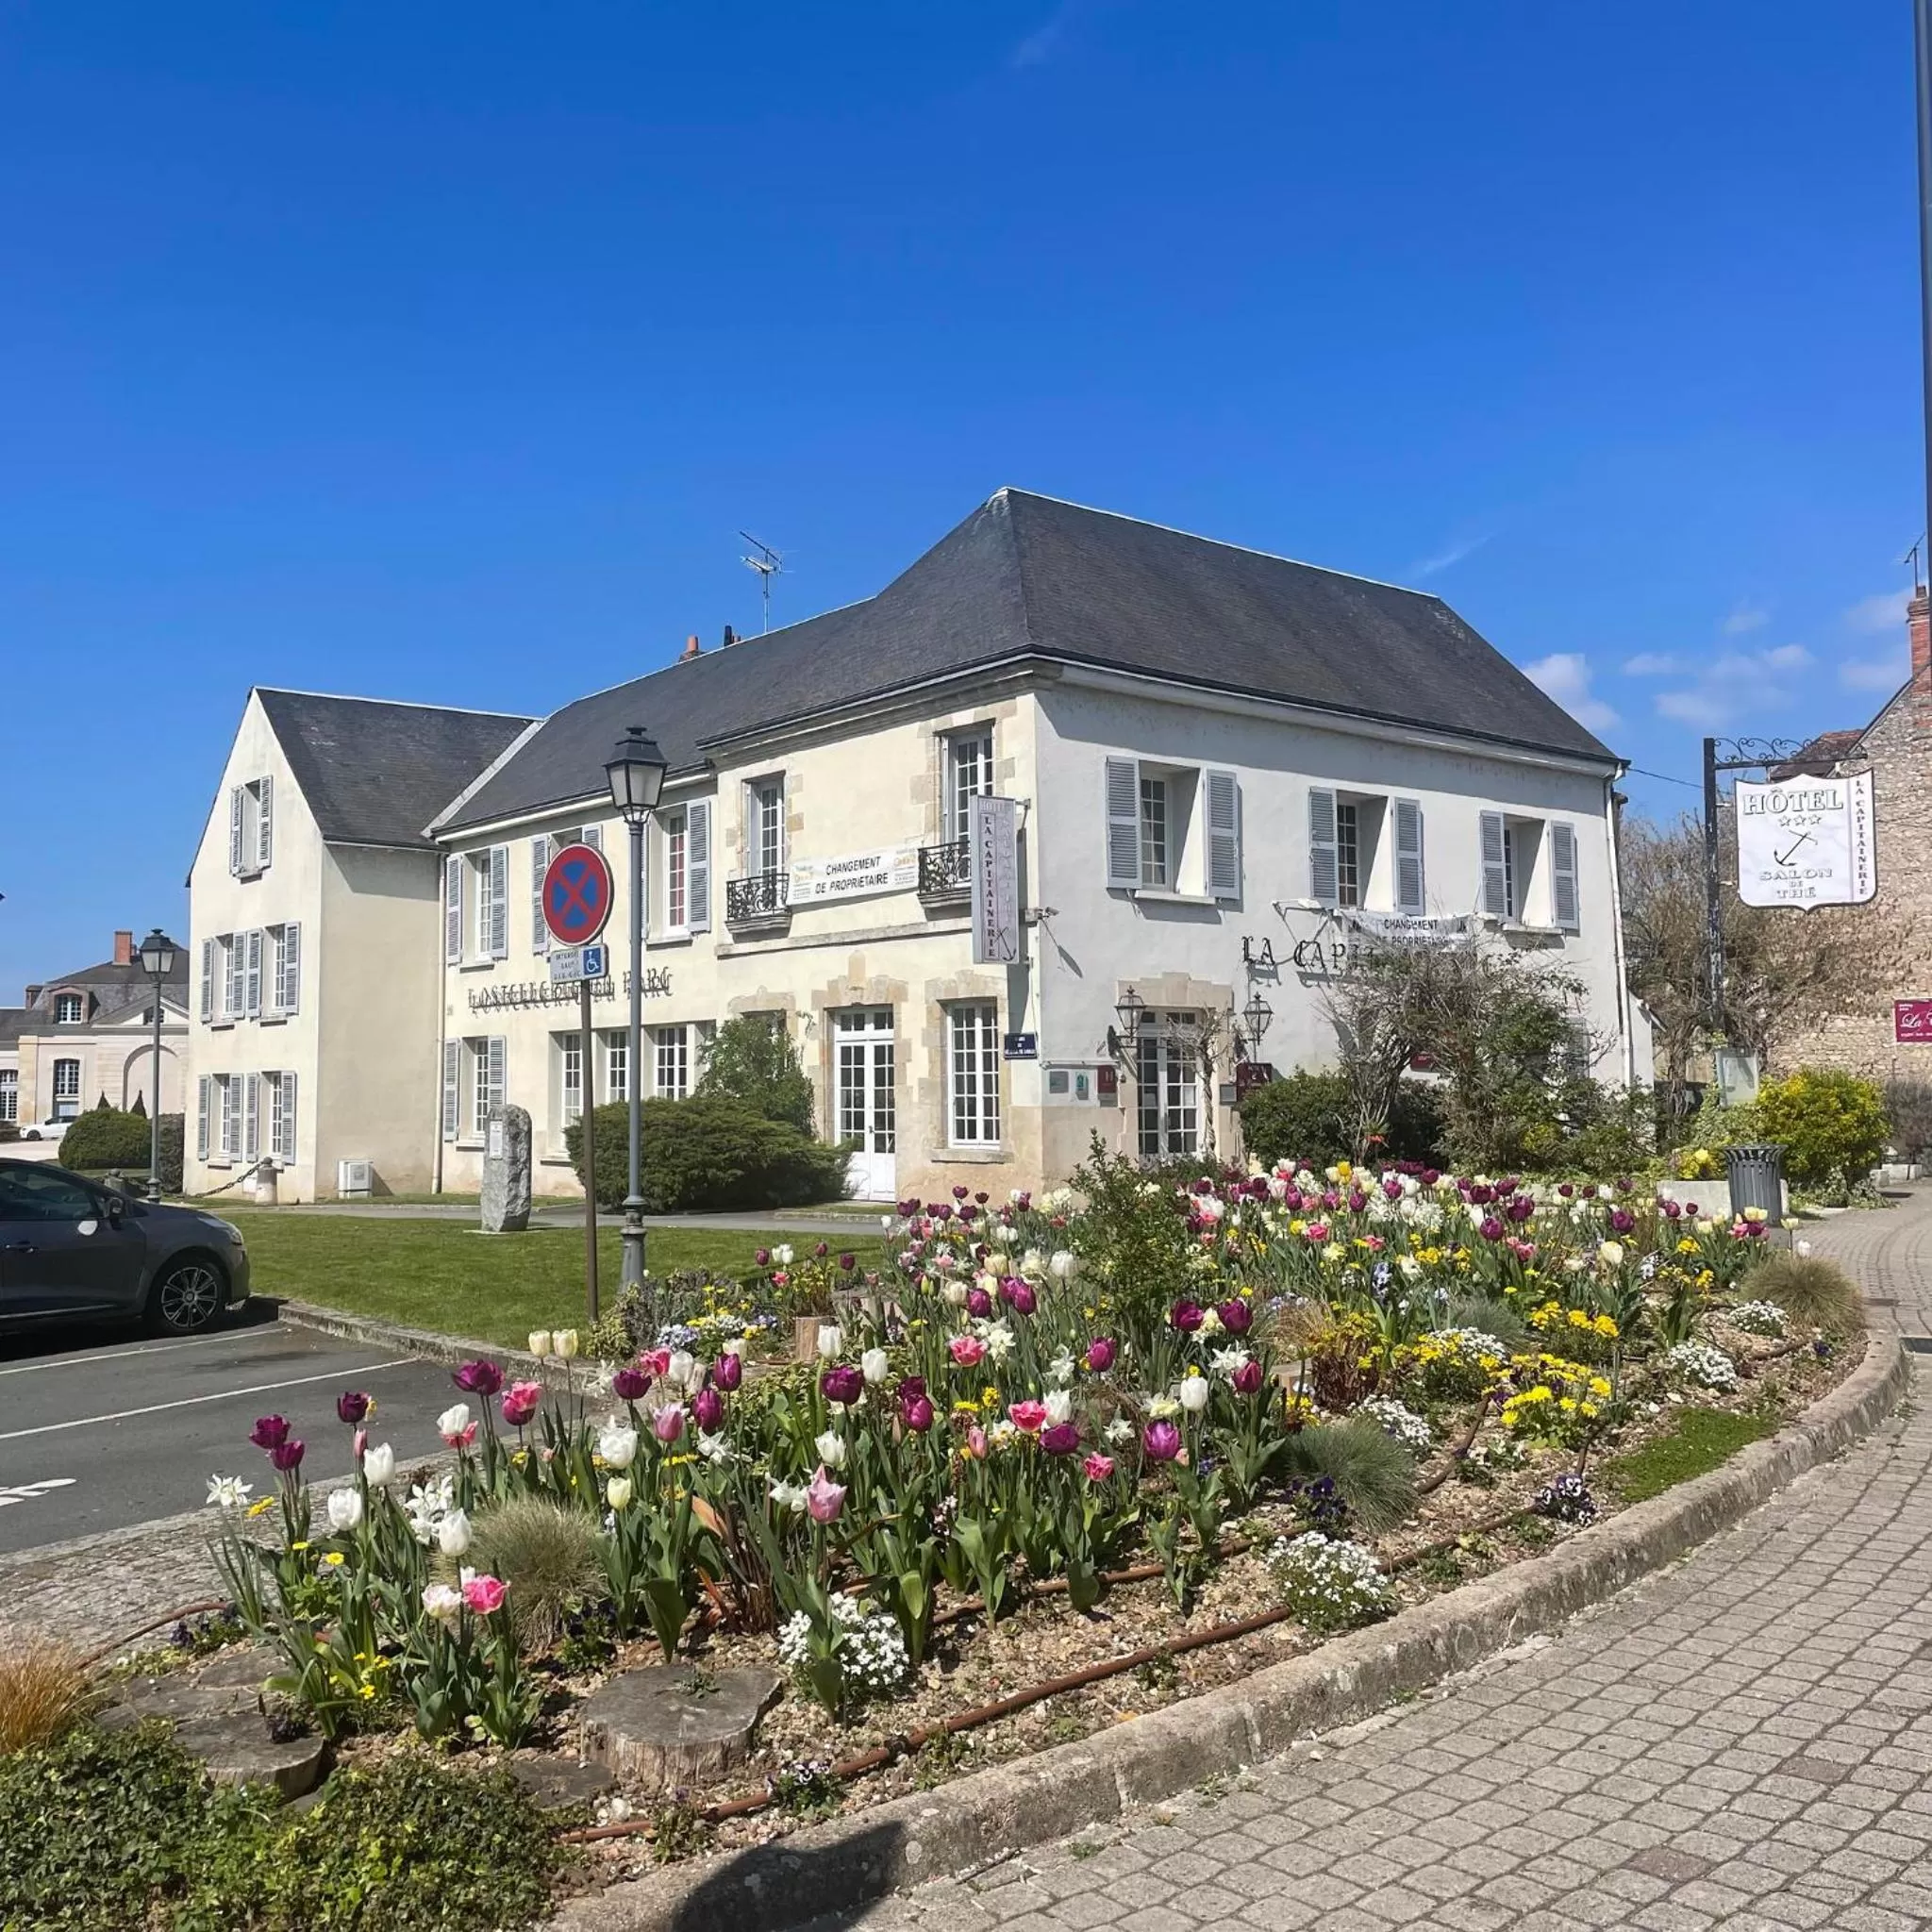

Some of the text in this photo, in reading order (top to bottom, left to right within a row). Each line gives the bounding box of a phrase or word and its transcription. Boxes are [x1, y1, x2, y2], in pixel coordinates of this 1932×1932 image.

[1742, 787, 1843, 815] HÔTEL
[1856, 780, 1868, 894] LA CAPITAINERIE
[825, 856, 881, 875] CHANGEMENT
[1759, 868, 1833, 880] SALON
[815, 882, 826, 894] DE
[829, 873, 889, 891] PROPRIETAIRE
[984, 816, 995, 957] LA CAPITAINERIE
[1241, 936, 1276, 966] LA
